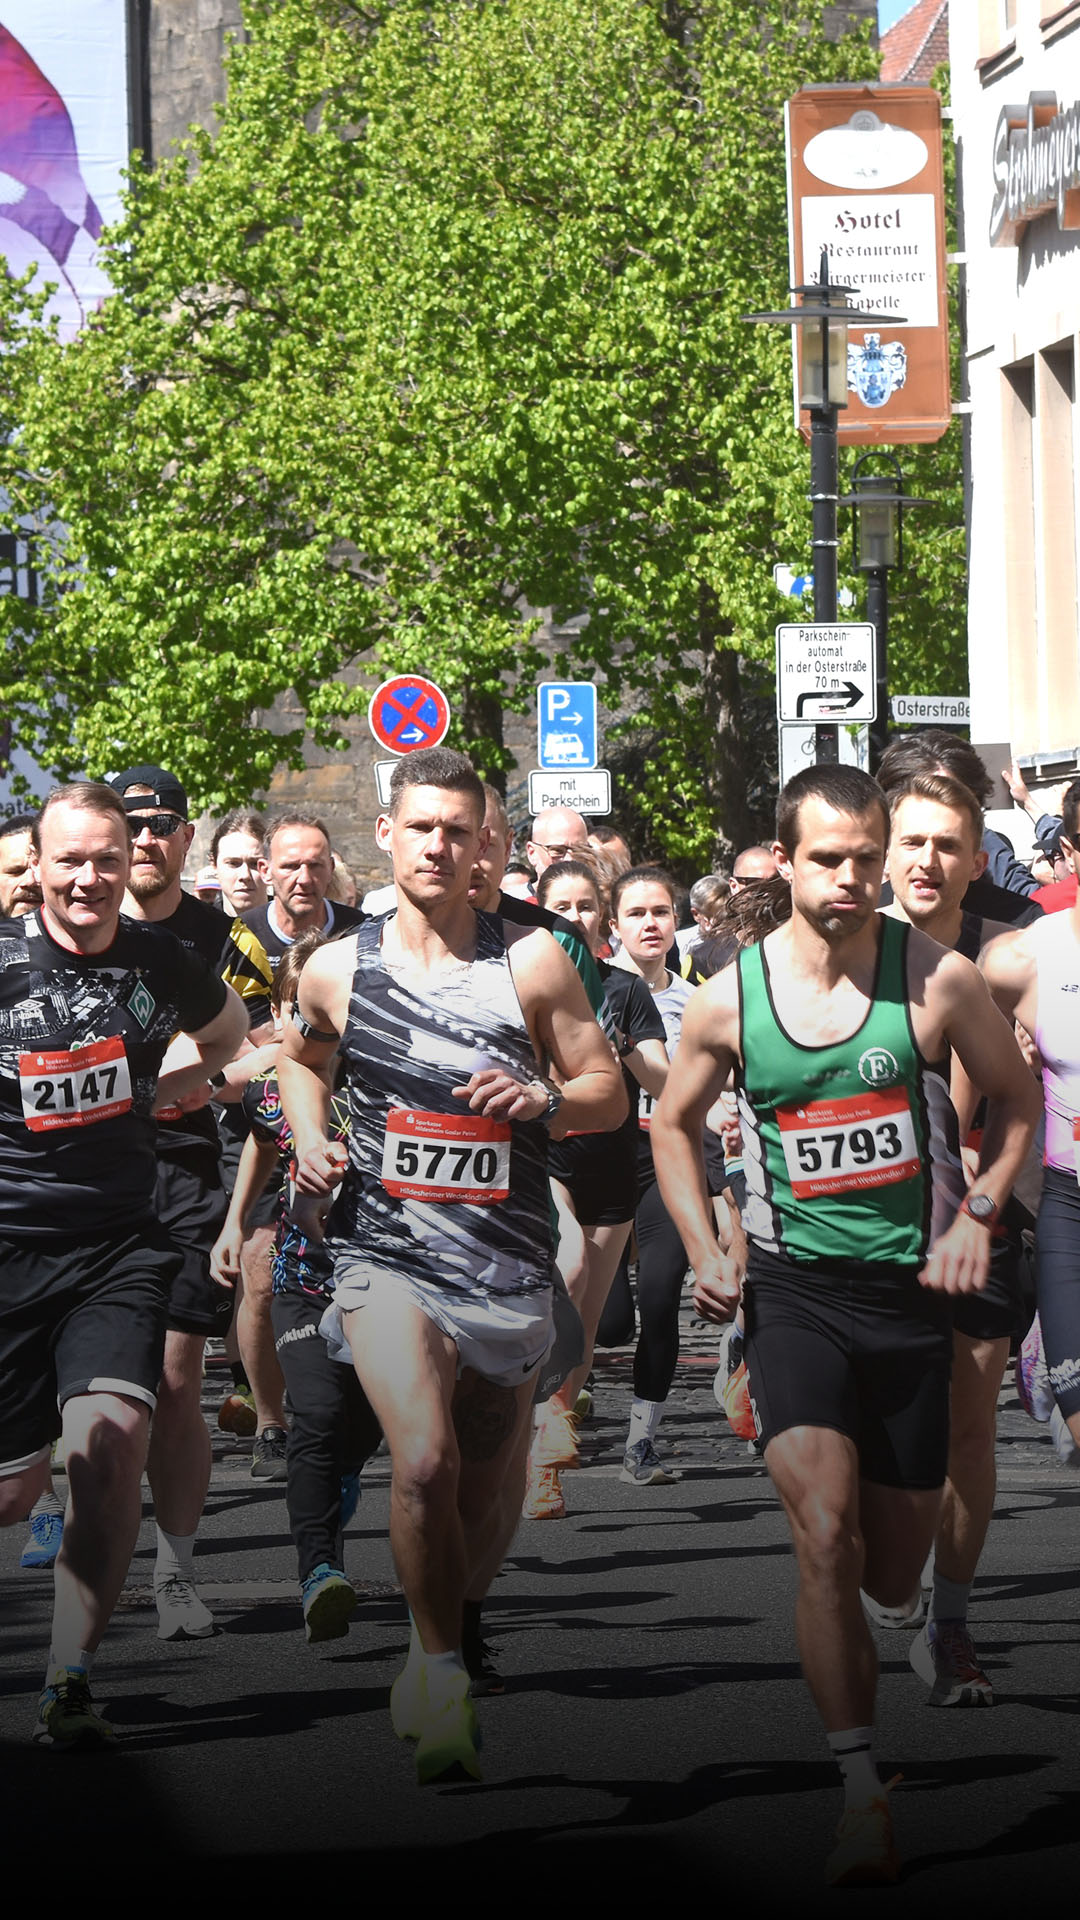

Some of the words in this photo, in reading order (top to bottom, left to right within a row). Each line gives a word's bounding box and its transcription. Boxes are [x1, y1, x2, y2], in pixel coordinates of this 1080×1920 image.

[835, 208, 901, 233] Hotel
[799, 630, 851, 642] Parkschein-
[808, 646, 843, 657] automat
[785, 662, 793, 673] in
[796, 661, 811, 673] der
[815, 660, 867, 673] Osterstraße
[815, 677, 827, 688] 70
[830, 679, 839, 688] m
[547, 689, 571, 721] P
[560, 778, 576, 791] mit
[542, 794, 600, 808] Parkschein
[33, 1066, 118, 1111] 2147
[796, 1122, 902, 1172] 5793
[395, 1140, 497, 1184] 5770
[400, 1188, 445, 1199] Hildesheimer
